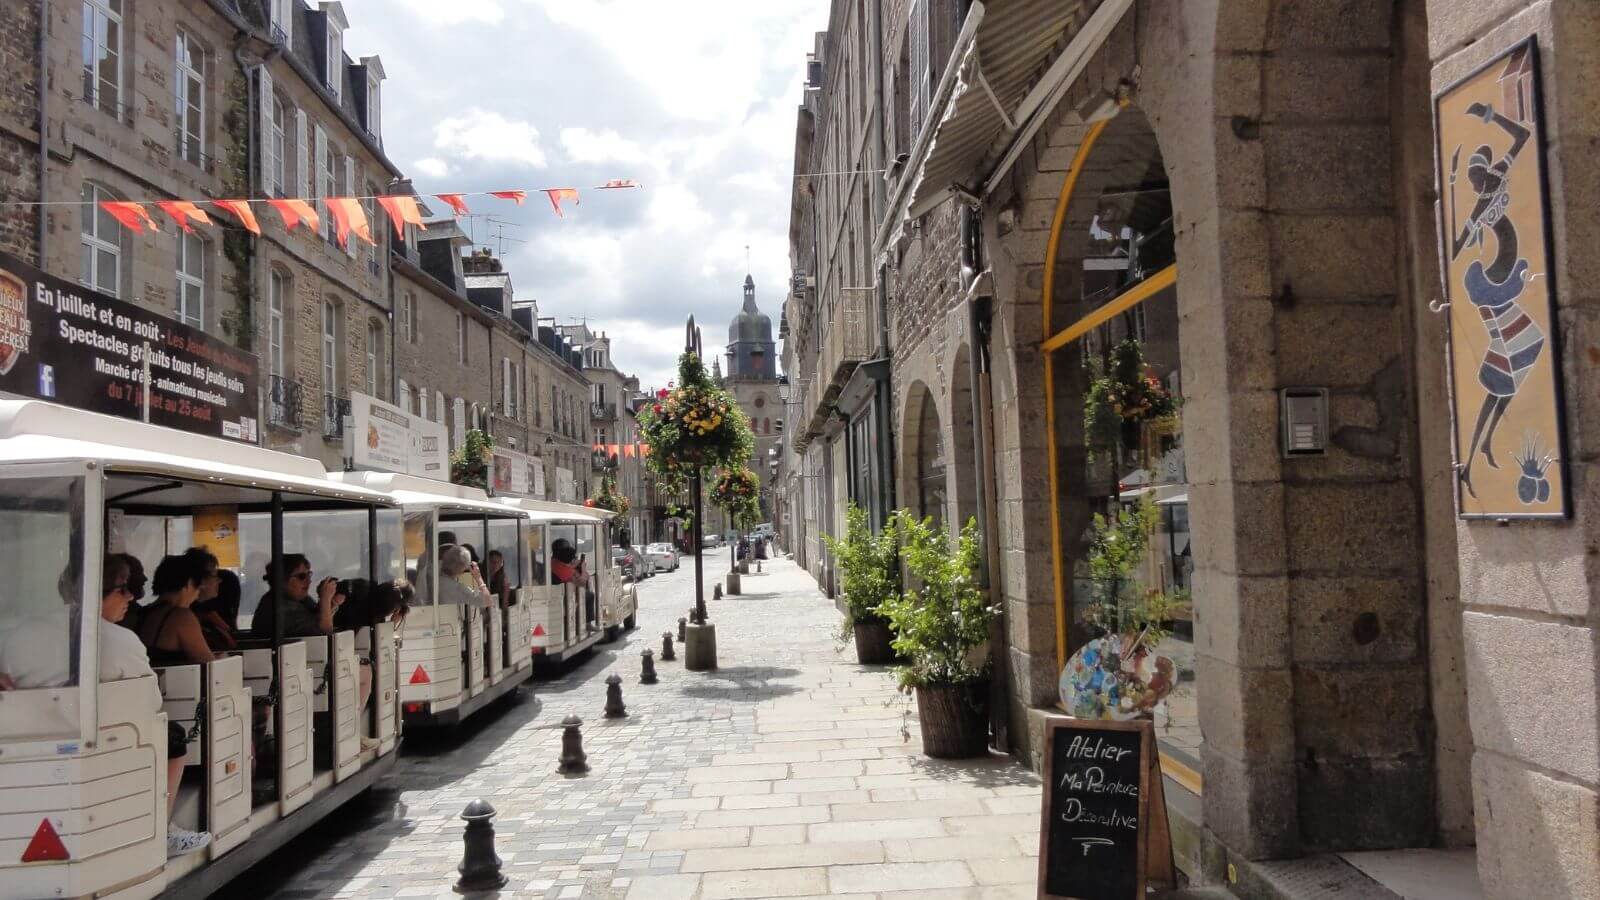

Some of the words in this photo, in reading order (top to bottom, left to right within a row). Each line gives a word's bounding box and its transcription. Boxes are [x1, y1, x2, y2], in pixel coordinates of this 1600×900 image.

[36, 281, 54, 306] En
[57, 289, 97, 320] juillet
[100, 308, 114, 326] et
[116, 315, 132, 332] en
[134, 321, 160, 341] août
[60, 319, 129, 356] Spectacles
[131, 345, 171, 368] grtuits
[172, 355, 192, 375] tous
[193, 362, 206, 380] les
[205, 366, 227, 388] jeudis
[227, 377, 244, 394] soirs
[95, 357, 130, 380] Marché
[131, 368, 152, 385] d'éé
[157, 378, 197, 398] animations
[108, 382, 123, 400] du
[126, 384, 132, 401] 7
[165, 399, 177, 413] au
[1066, 735, 1133, 762] Atelier
[1060, 773, 1083, 790] Ma
